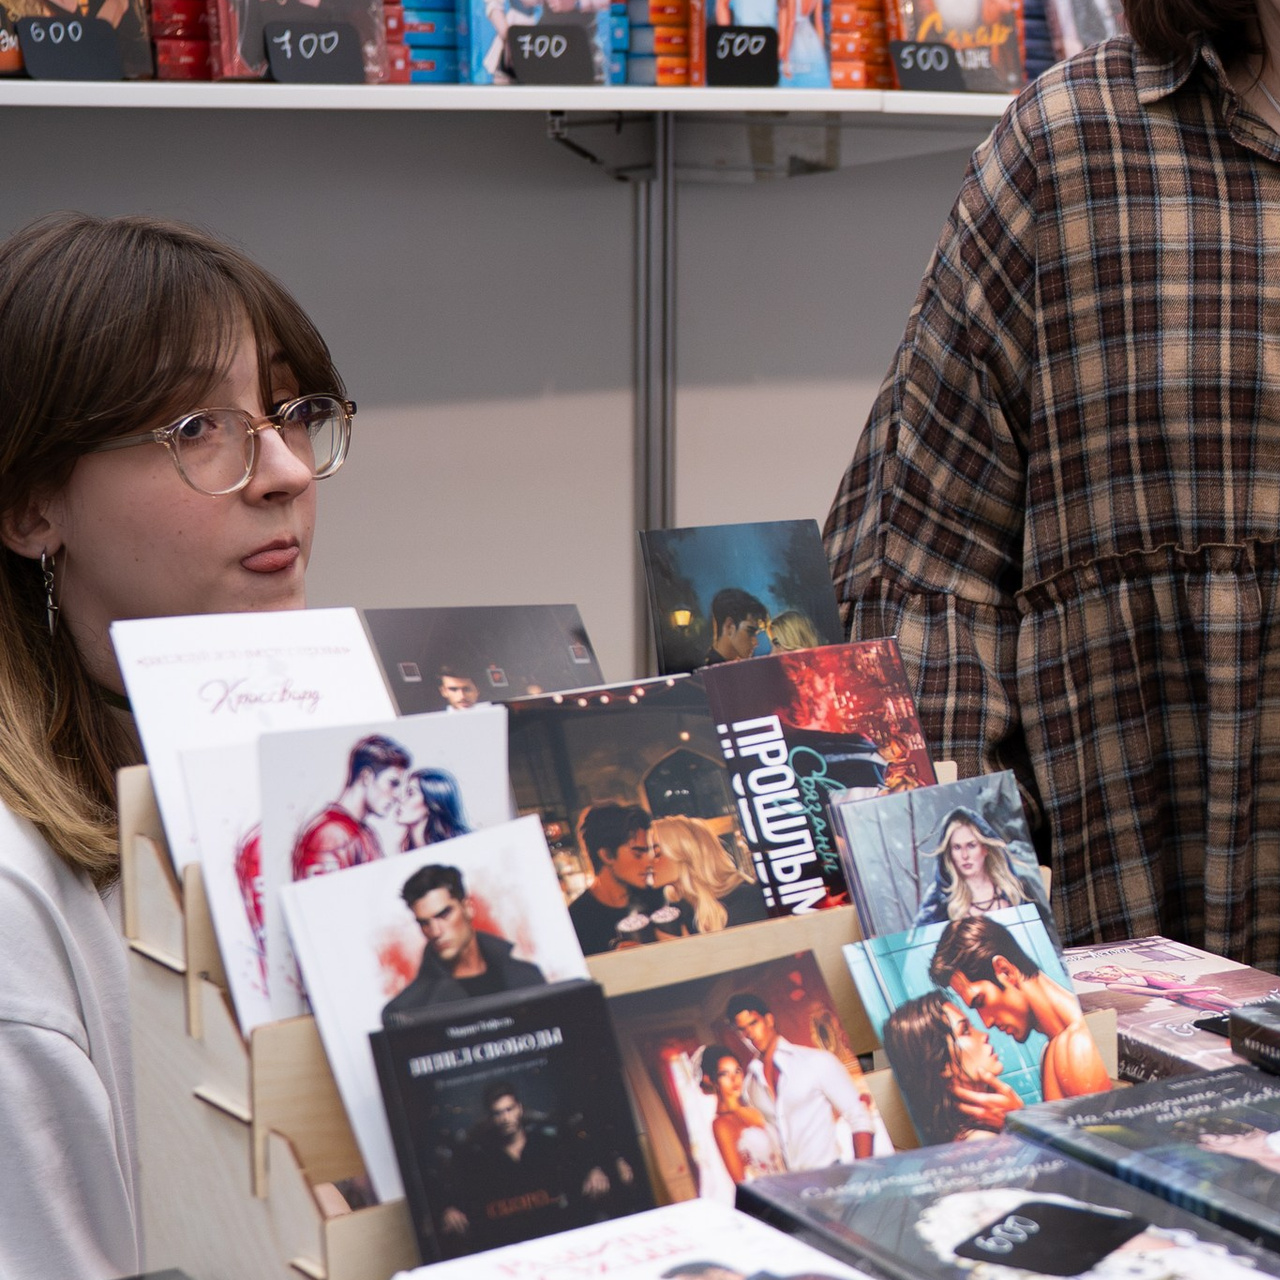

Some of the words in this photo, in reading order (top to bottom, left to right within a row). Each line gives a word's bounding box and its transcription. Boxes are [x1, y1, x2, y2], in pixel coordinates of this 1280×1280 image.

[29, 20, 83, 44] 600
[273, 30, 340, 60] 700
[517, 34, 568, 60] 700
[717, 32, 767, 59] 500
[900, 48, 949, 72] 500
[973, 1214, 1040, 1255] 600
